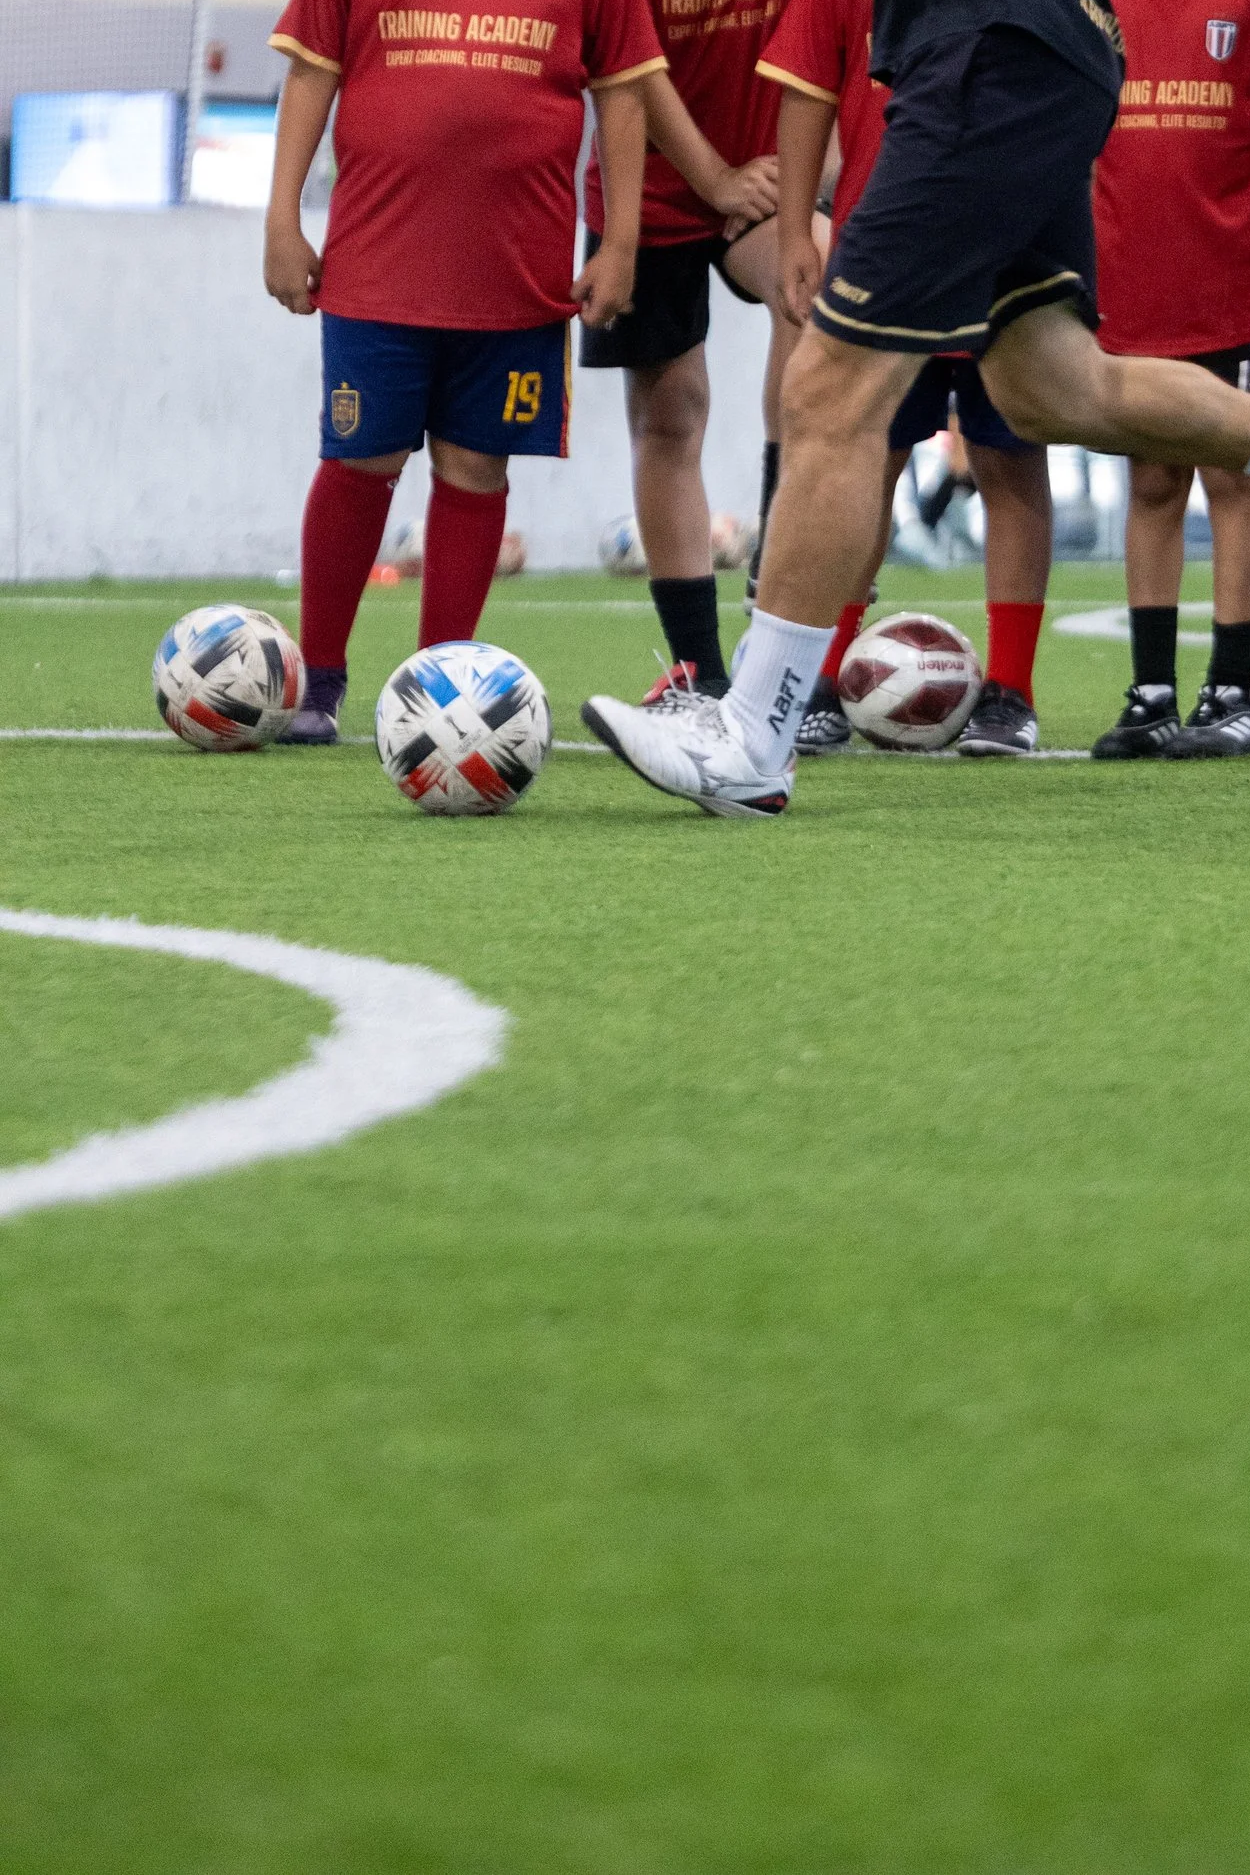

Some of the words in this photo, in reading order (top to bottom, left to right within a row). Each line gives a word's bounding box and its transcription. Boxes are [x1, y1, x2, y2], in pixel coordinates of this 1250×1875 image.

[378, 10, 463, 41] TRAINING
[465, 14, 558, 52] ACADEMY
[386, 49, 415, 67] EXPERT
[471, 51, 500, 69] ELITE
[1155, 80, 1235, 109] ACADEMY
[502, 371, 542, 423] 19
[917, 659, 965, 672] molten
[766, 666, 803, 736] ABFT
